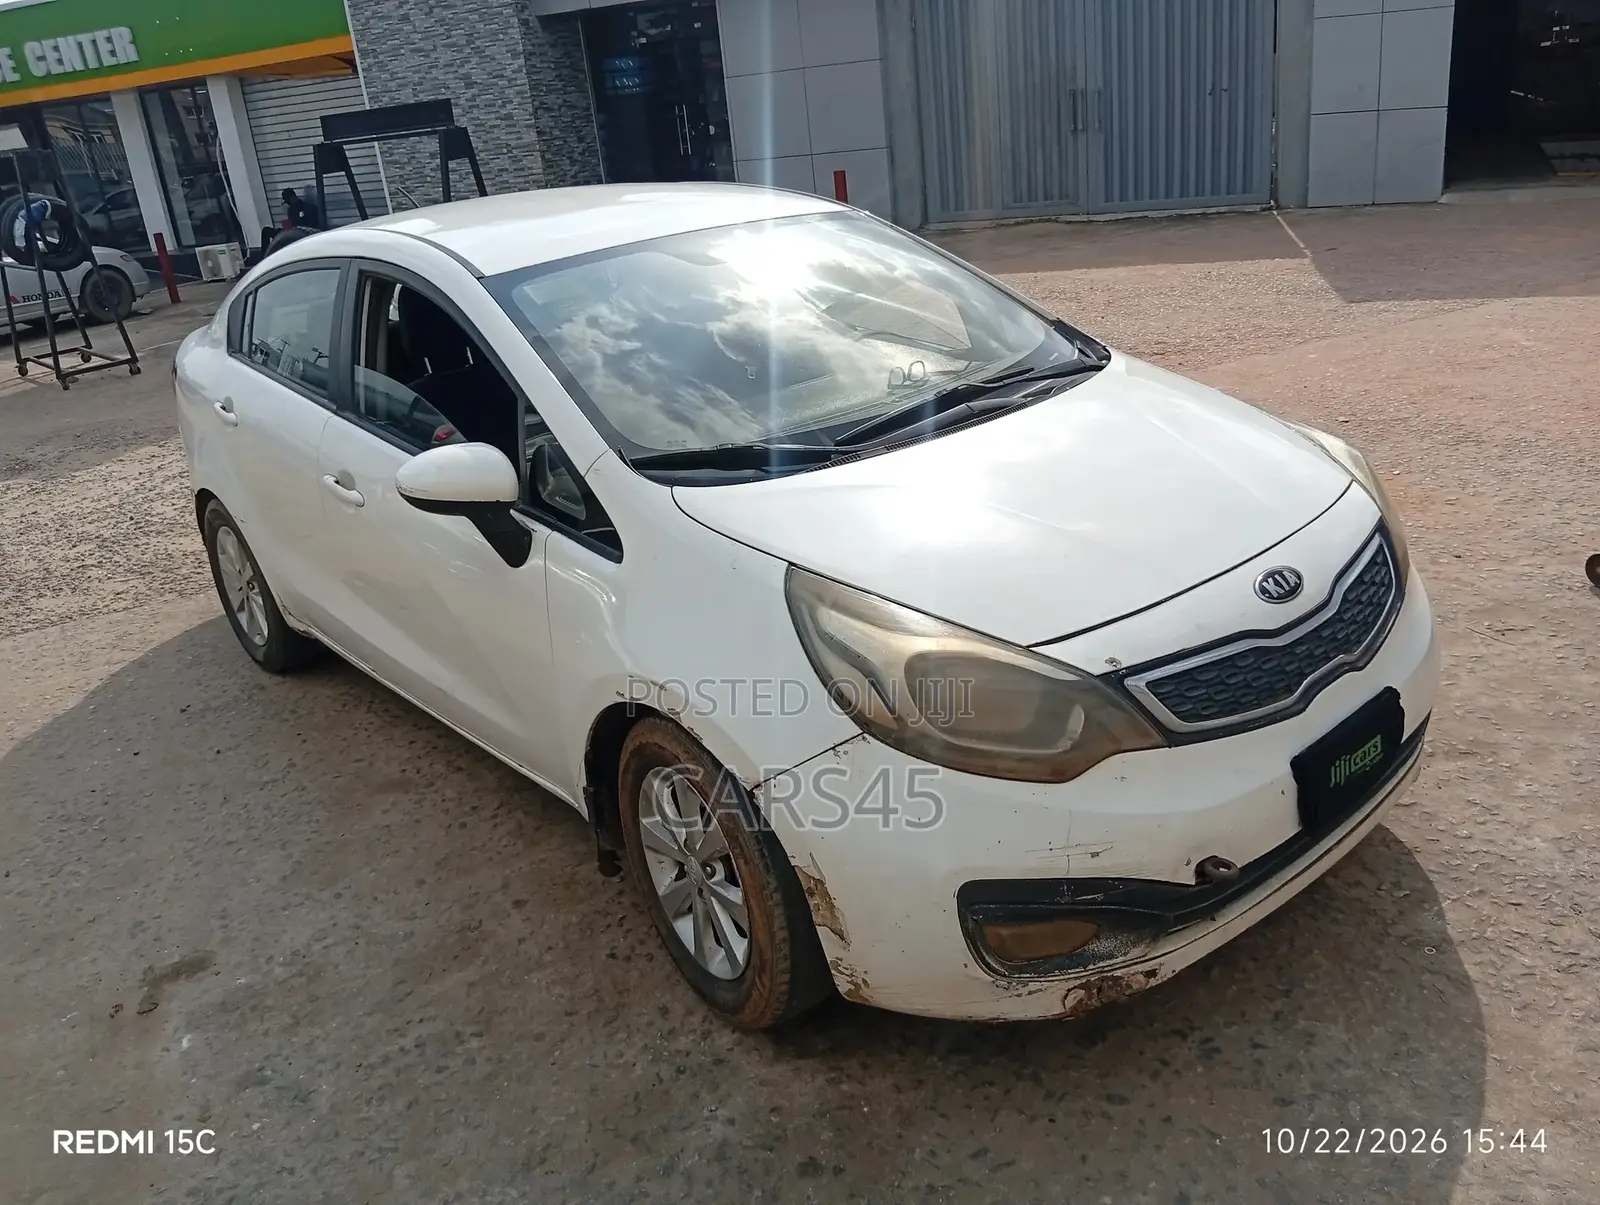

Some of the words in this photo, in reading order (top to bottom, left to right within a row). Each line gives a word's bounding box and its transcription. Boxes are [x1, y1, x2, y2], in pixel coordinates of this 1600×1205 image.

[0, 47, 21, 84] E
[24, 26, 139, 78] CENTER
[1262, 570, 1300, 598] KIA
